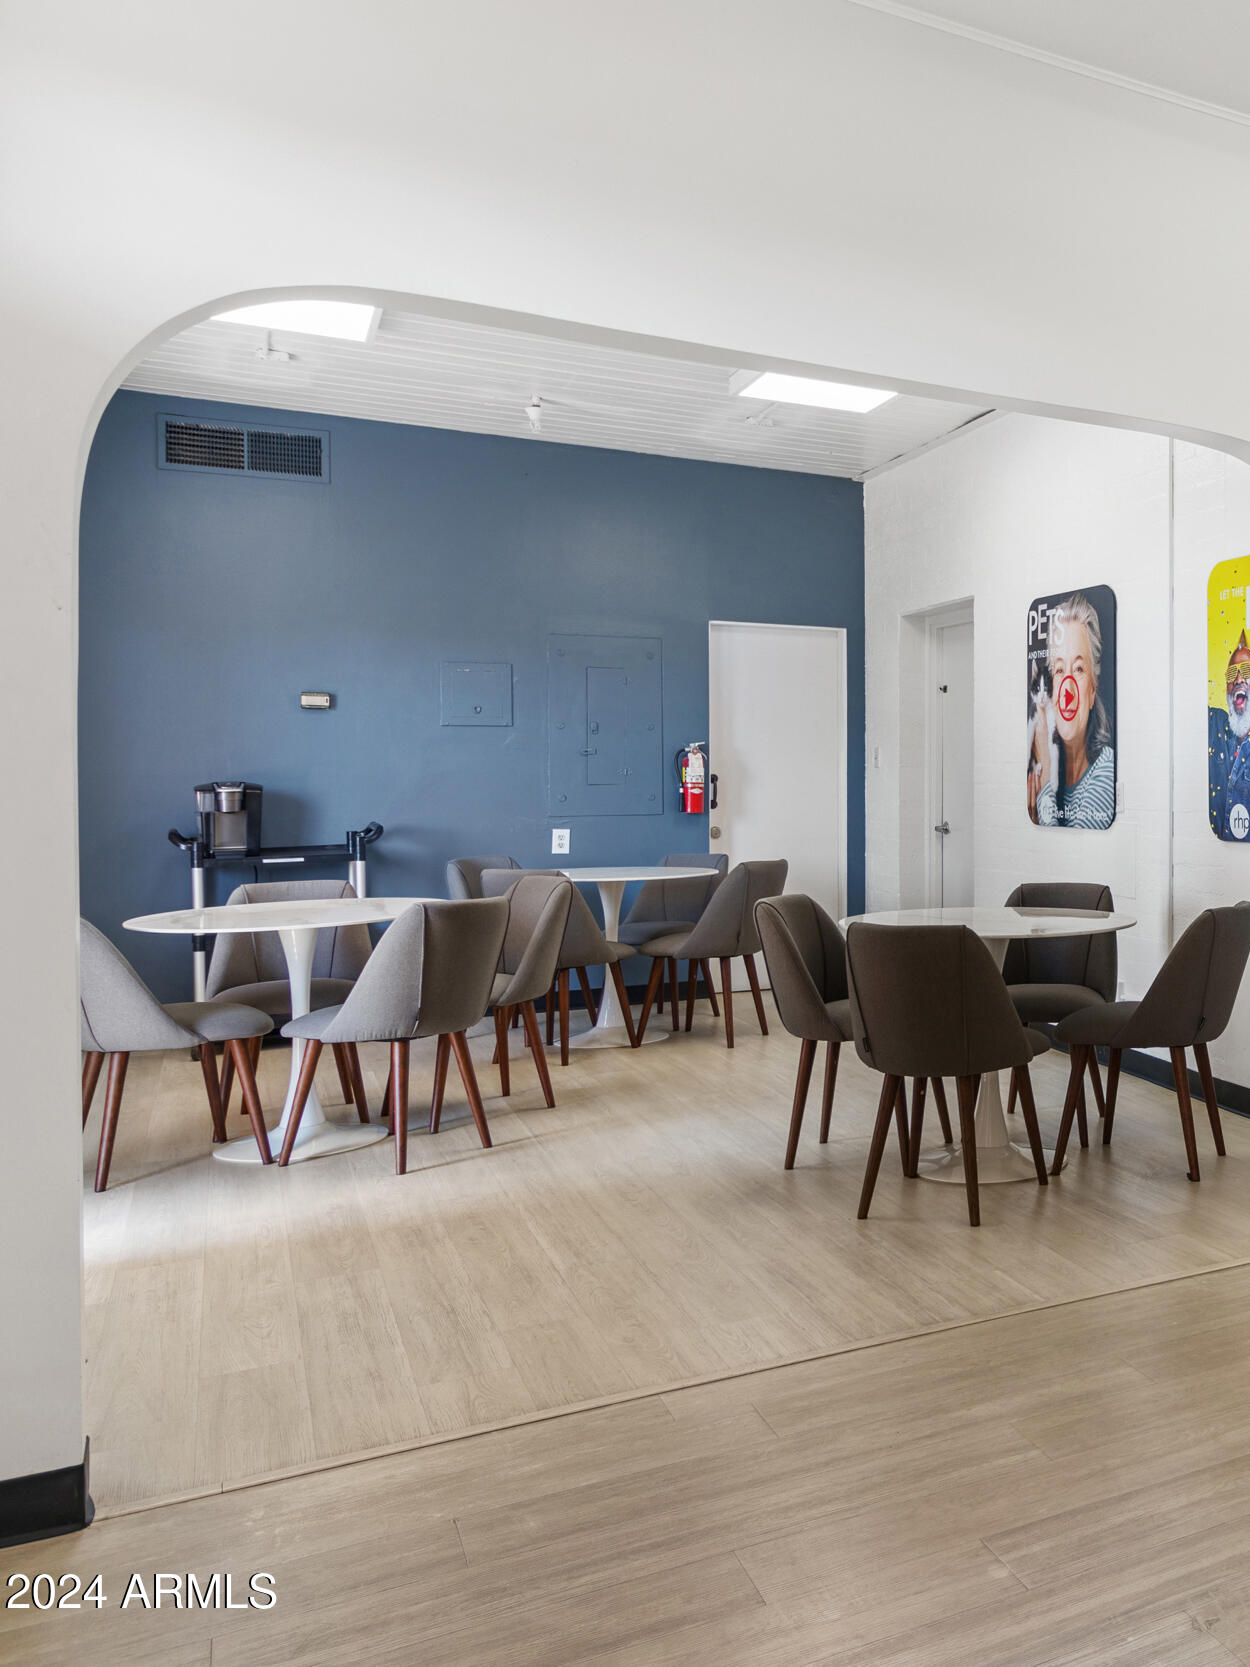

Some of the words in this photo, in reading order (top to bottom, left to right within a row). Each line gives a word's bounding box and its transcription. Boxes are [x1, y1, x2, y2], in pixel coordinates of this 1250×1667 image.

[1219, 589, 1230, 600] LET
[1231, 586, 1244, 598] THE
[1028, 603, 1065, 646] PETS
[1233, 811, 1249, 832] rhp
